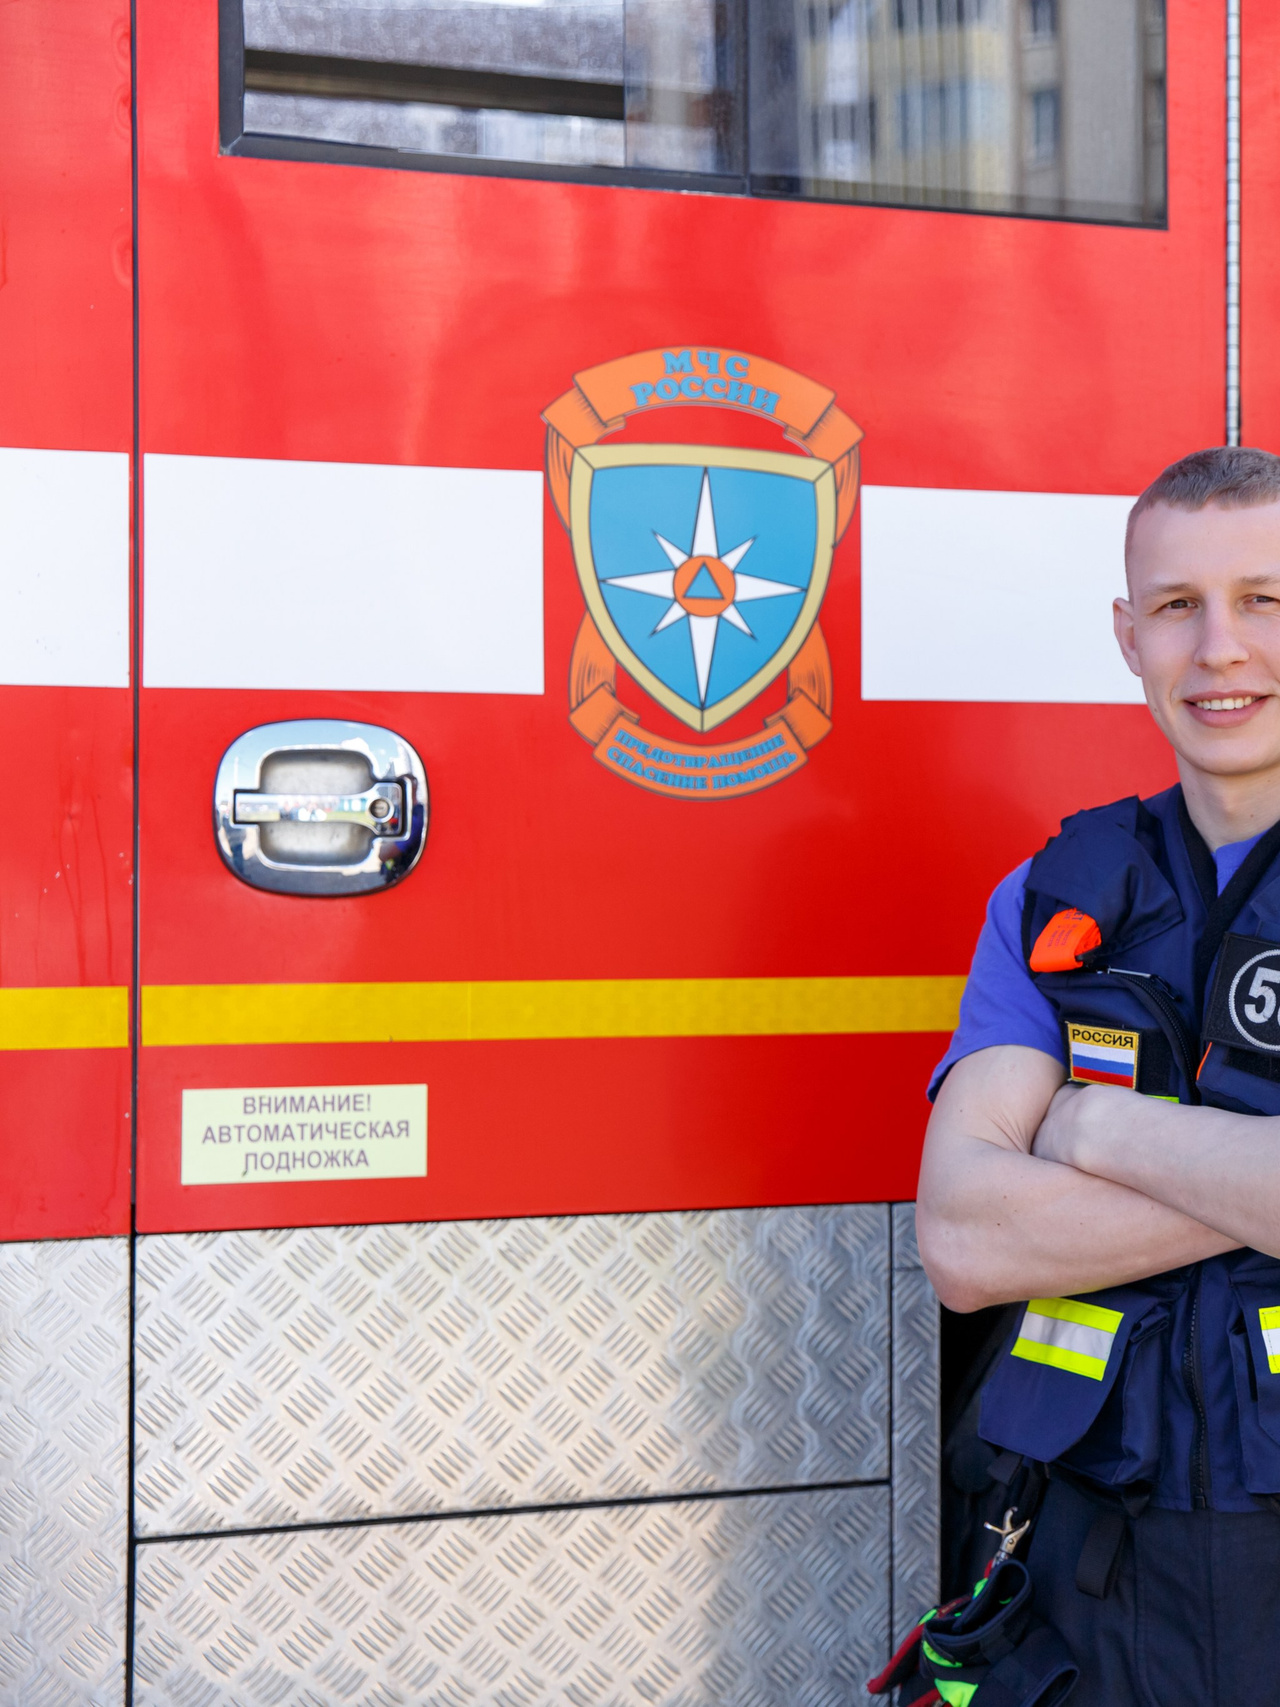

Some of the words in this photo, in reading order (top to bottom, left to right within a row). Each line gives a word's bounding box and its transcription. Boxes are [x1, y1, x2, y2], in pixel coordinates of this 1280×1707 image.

[662, 350, 750, 379] МЧС
[629, 375, 781, 415] РОССИИ
[606, 746, 709, 790] СПАСЕНИЕ
[711, 750, 798, 790] ПОМОЩЬ
[1072, 1028, 1134, 1048] РОССИЯ
[242, 1093, 372, 1115] ВНИМАНИЕ!
[202, 1119, 411, 1144] АВТОМАТИЧЕСКАЯ
[244, 1149, 370, 1174] ПОДНОЖКА
